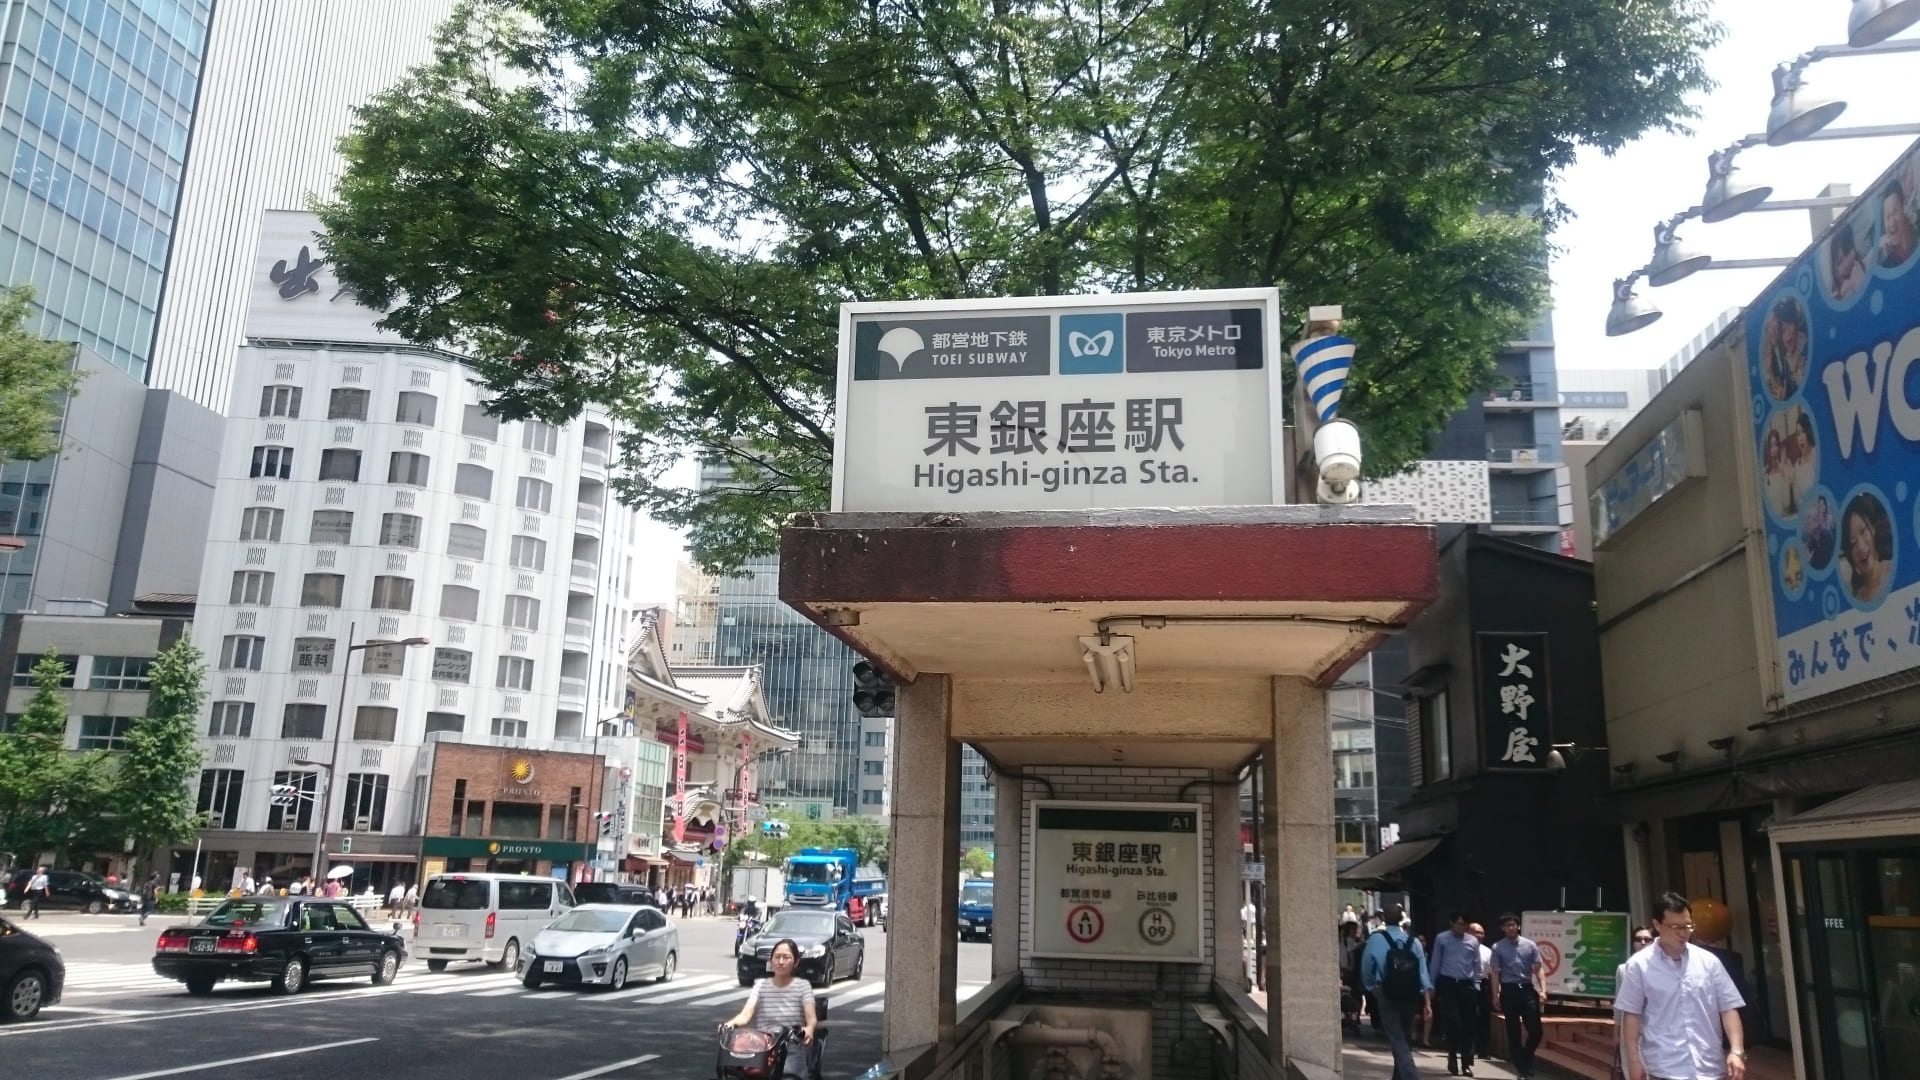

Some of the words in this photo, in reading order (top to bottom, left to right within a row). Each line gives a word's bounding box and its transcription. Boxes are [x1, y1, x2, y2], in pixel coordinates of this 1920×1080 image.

[932, 330, 1029, 349] 都営地下鉄
[1146, 323, 1242, 344] 東京メトロ
[931, 353, 964, 366] TOEI
[968, 351, 1028, 365] SUBWAY
[1153, 345, 1193, 360] Tokyo
[1195, 343, 1237, 357] Metro
[922, 397, 1186, 458] 東銀座駅
[913, 461, 1128, 494] Higashi-ginza
[1139, 459, 1199, 485] Sta.
[298, 653, 328, 667] 眼科
[1497, 642, 1539, 763] 大野屋
[502, 787, 541, 796] PRONTO
[1171, 816, 1190, 829] A1
[502, 845, 542, 854] PRONTO
[1071, 841, 1162, 865] 東銀座駅
[1066, 864, 1143, 877] Higashi-ginza
[1145, 865, 1168, 877] Sta.
[1080, 911, 1090, 922] A
[1152, 913, 1162, 924] H
[1077, 923, 1092, 935] 11
[1148, 926, 1167, 937] 09
